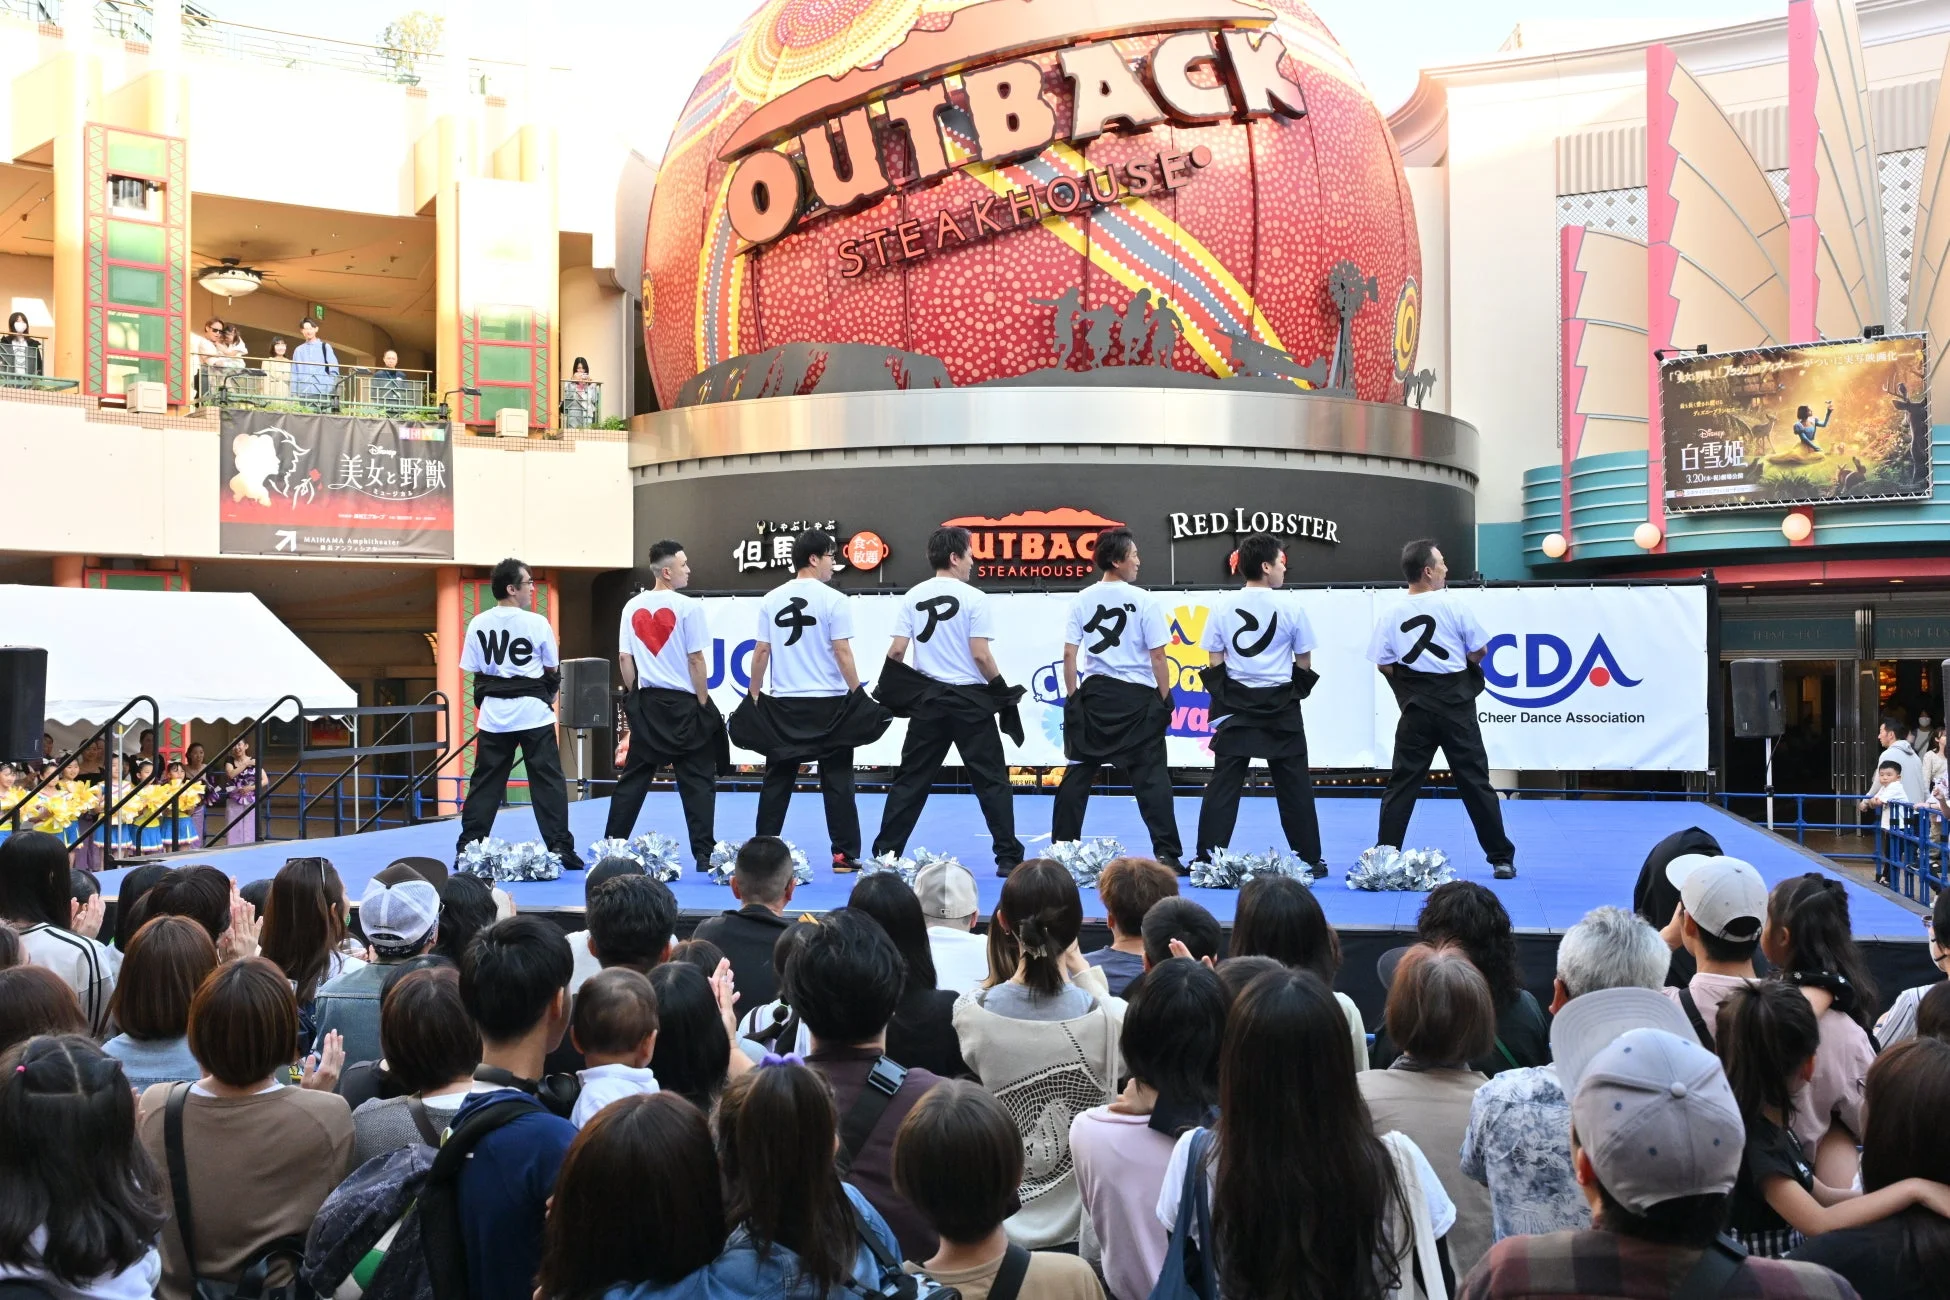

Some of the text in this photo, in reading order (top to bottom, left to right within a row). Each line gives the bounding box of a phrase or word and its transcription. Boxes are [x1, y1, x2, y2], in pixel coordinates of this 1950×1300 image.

[726, 27, 1308, 247] OUTBACK
[837, 147, 1194, 280] STEAKHOUSE
[1698, 428, 1725, 439] Disney
[367, 443, 397, 458] Disney
[1681, 440, 1749, 471] 白雪姫
[339, 453, 446, 489] 美女と野獣
[373, 488, 413, 497] ミュージカル
[304, 536, 400, 546] MAIHAMA Amphitheater
[769, 520, 836, 532] しゃぶしゃぶ
[1170, 507, 1340, 543] RED LOBSTER
[733, 535, 846, 573] 但馬
[853, 537, 879, 549] 食べ
[853, 549, 879, 563] 放題
[970, 532, 1098, 560] UTBAC
[978, 565, 1084, 577] STEAKHOUSE
[775, 597, 817, 646] チ
[915, 595, 960, 643] ア
[1083, 603, 1137, 655] ダ
[1232, 607, 1278, 659] ン
[476, 629, 534, 667] We
[1400, 613, 1450, 664] ス
[1478, 711, 1645, 723] Cheer Dance Association
